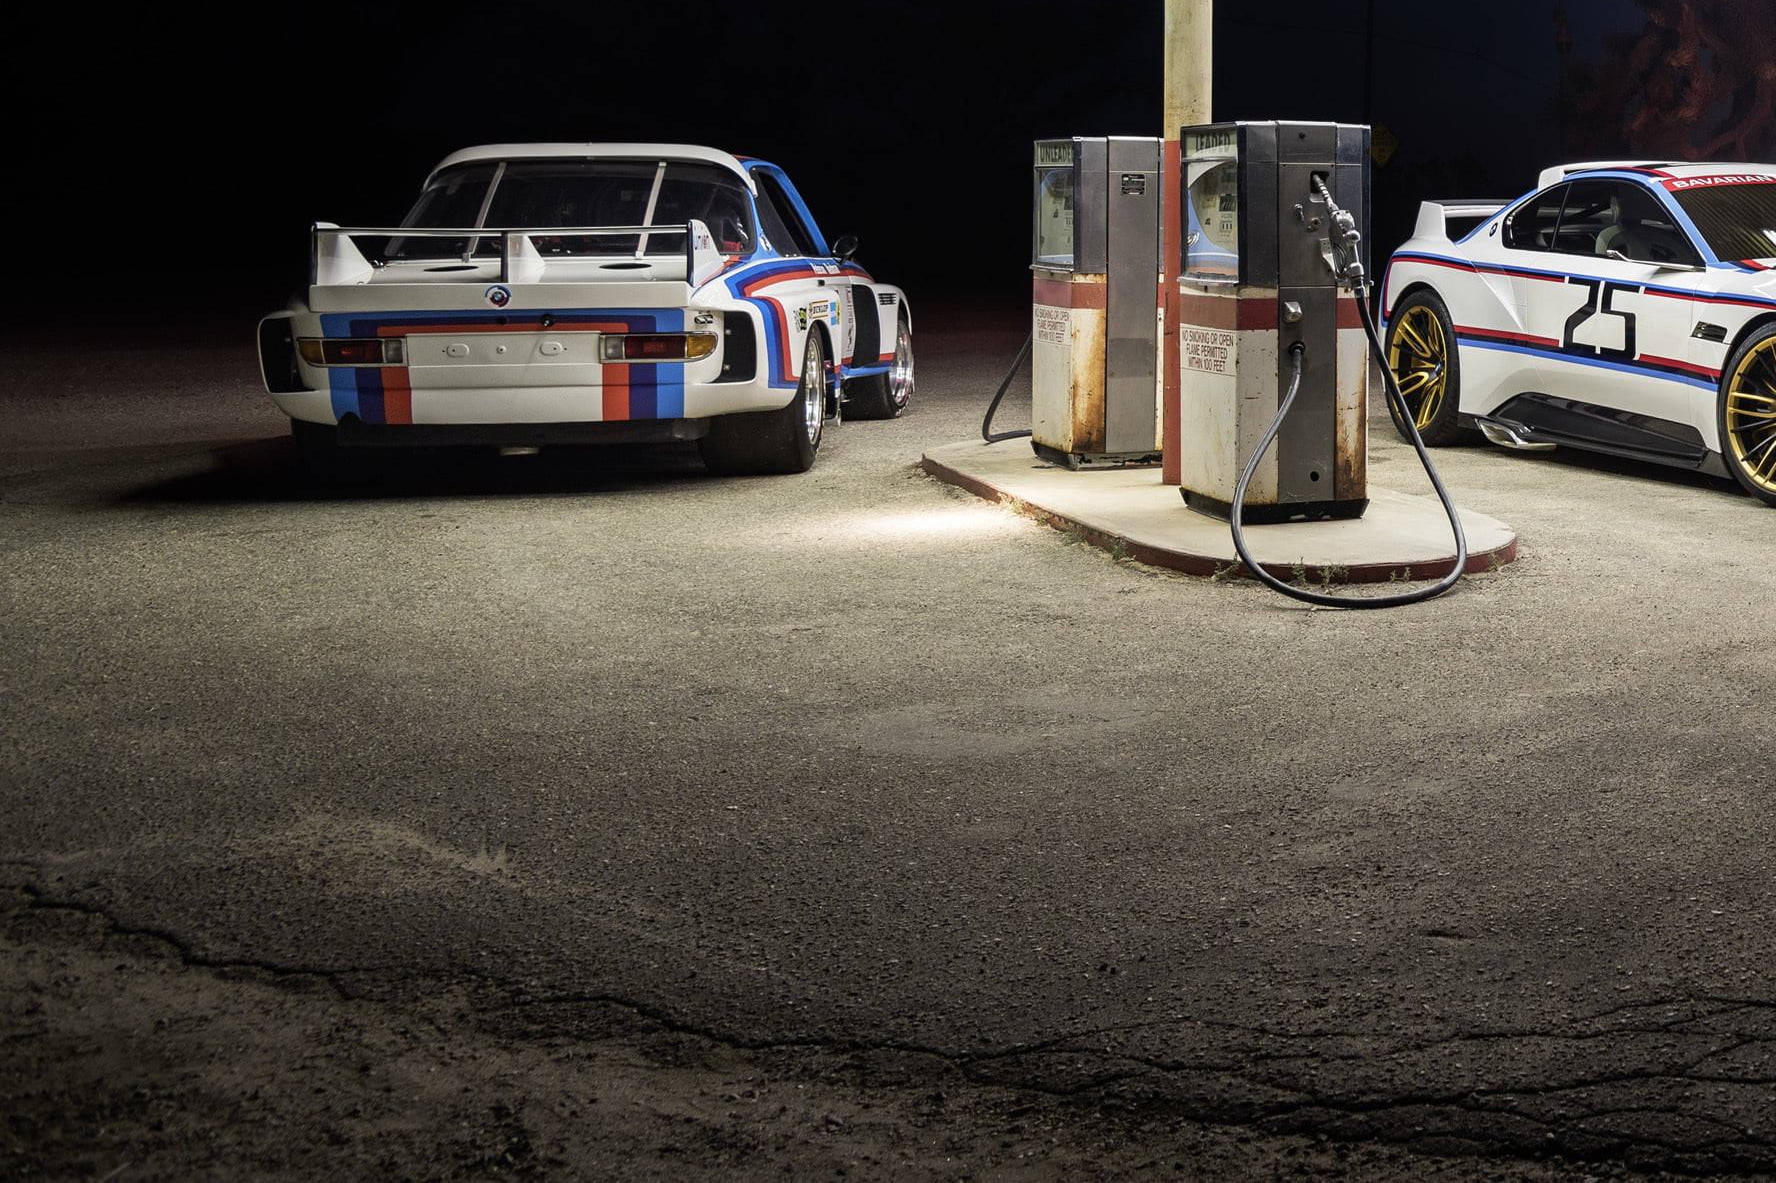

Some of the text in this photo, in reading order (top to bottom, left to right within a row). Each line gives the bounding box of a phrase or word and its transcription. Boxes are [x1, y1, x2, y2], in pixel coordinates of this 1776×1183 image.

[1195, 130, 1231, 154] LEADED
[1671, 174, 1773, 189] BAVARIAN
[1562, 276, 1641, 359] 25
[1189, 330, 1210, 345] SMOKING
[1219, 333, 1234, 347] OPEN
[1186, 342, 1228, 360] FLAME PERMITTED
[1213, 359, 1226, 373] FEET
